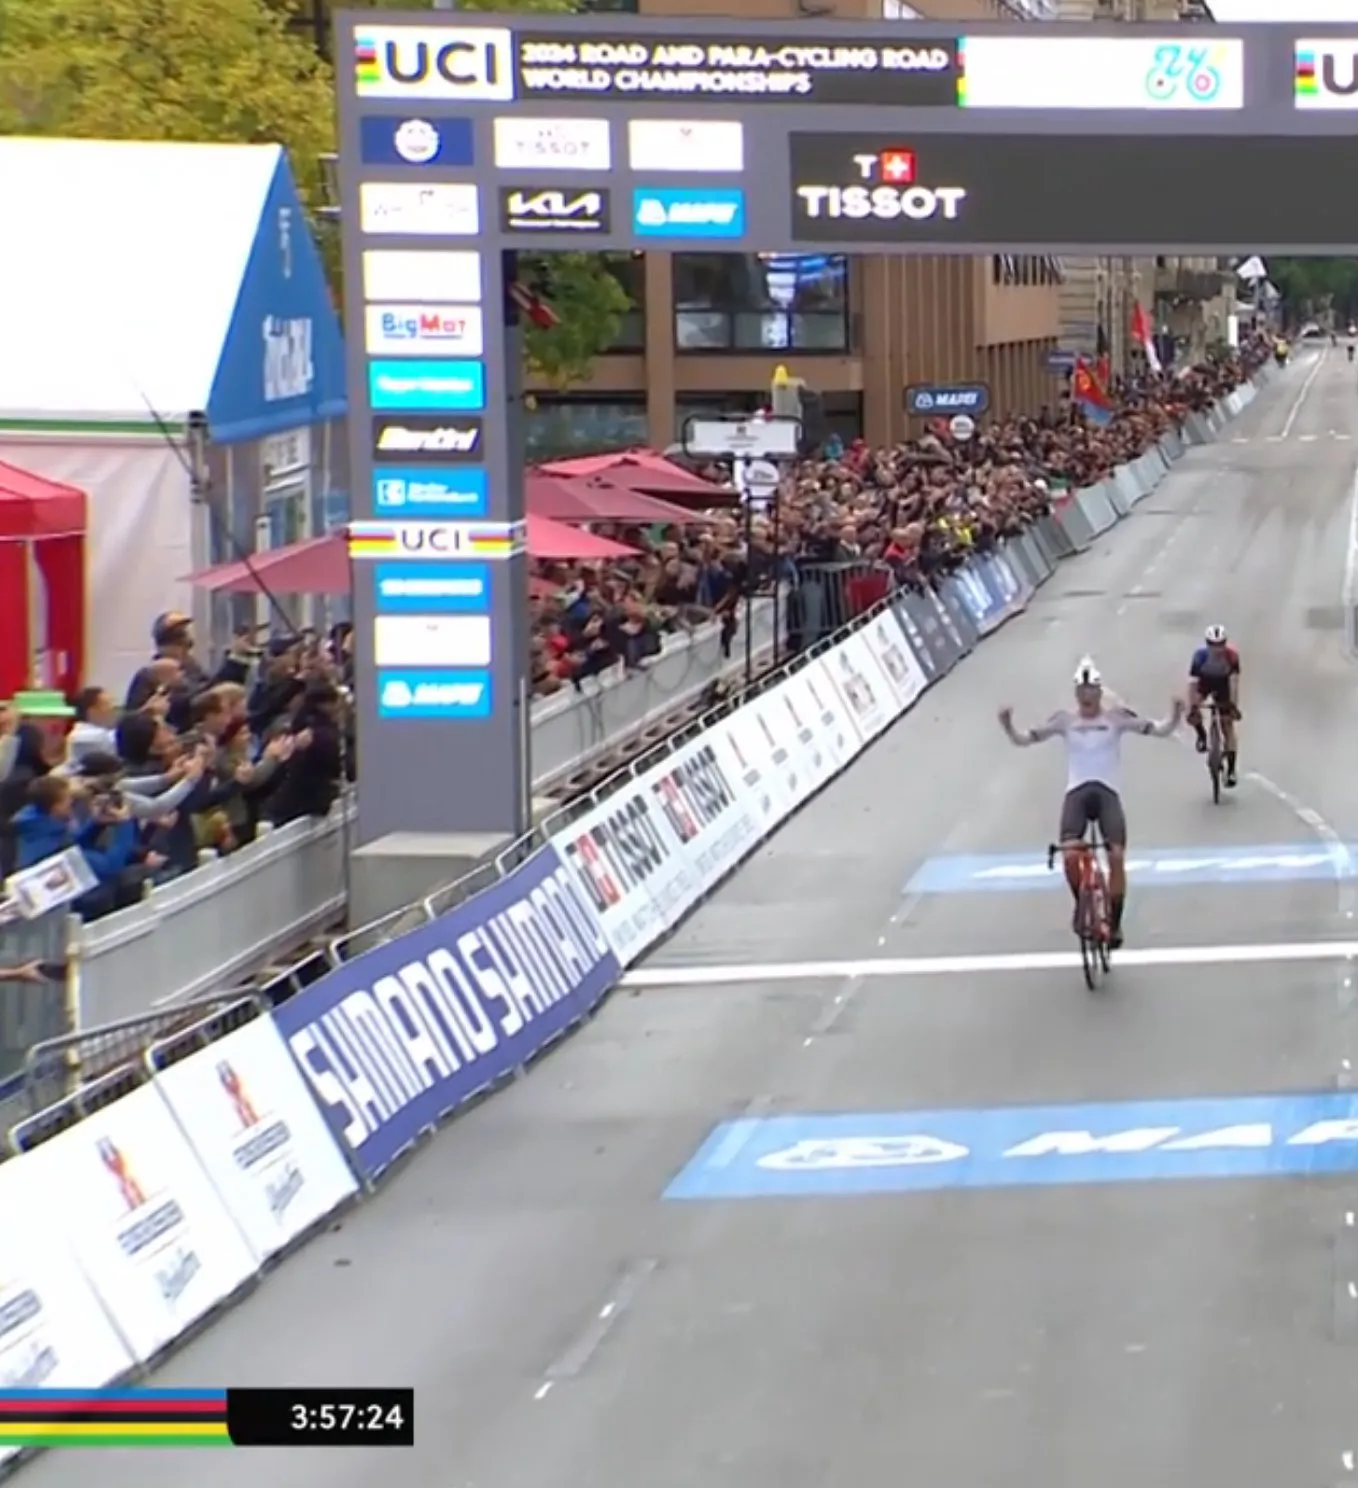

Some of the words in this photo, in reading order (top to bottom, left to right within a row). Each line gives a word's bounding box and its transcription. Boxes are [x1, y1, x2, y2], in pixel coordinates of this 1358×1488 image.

[385, 40, 498, 84] UCI
[579, 44, 648, 65] ROAD
[652, 45, 705, 66] AND
[707, 46, 878, 70] PARA-CYCLING
[882, 48, 949, 70] ROAD
[521, 68, 612, 90] WORLD
[615, 70, 812, 93] CHAMPIONSHIPS
[797, 186, 966, 219] TISSOT
[401, 528, 461, 551] UCI
[289, 947, 498, 1149] SHIMANO
[457, 866, 609, 1038] SHIMANO
